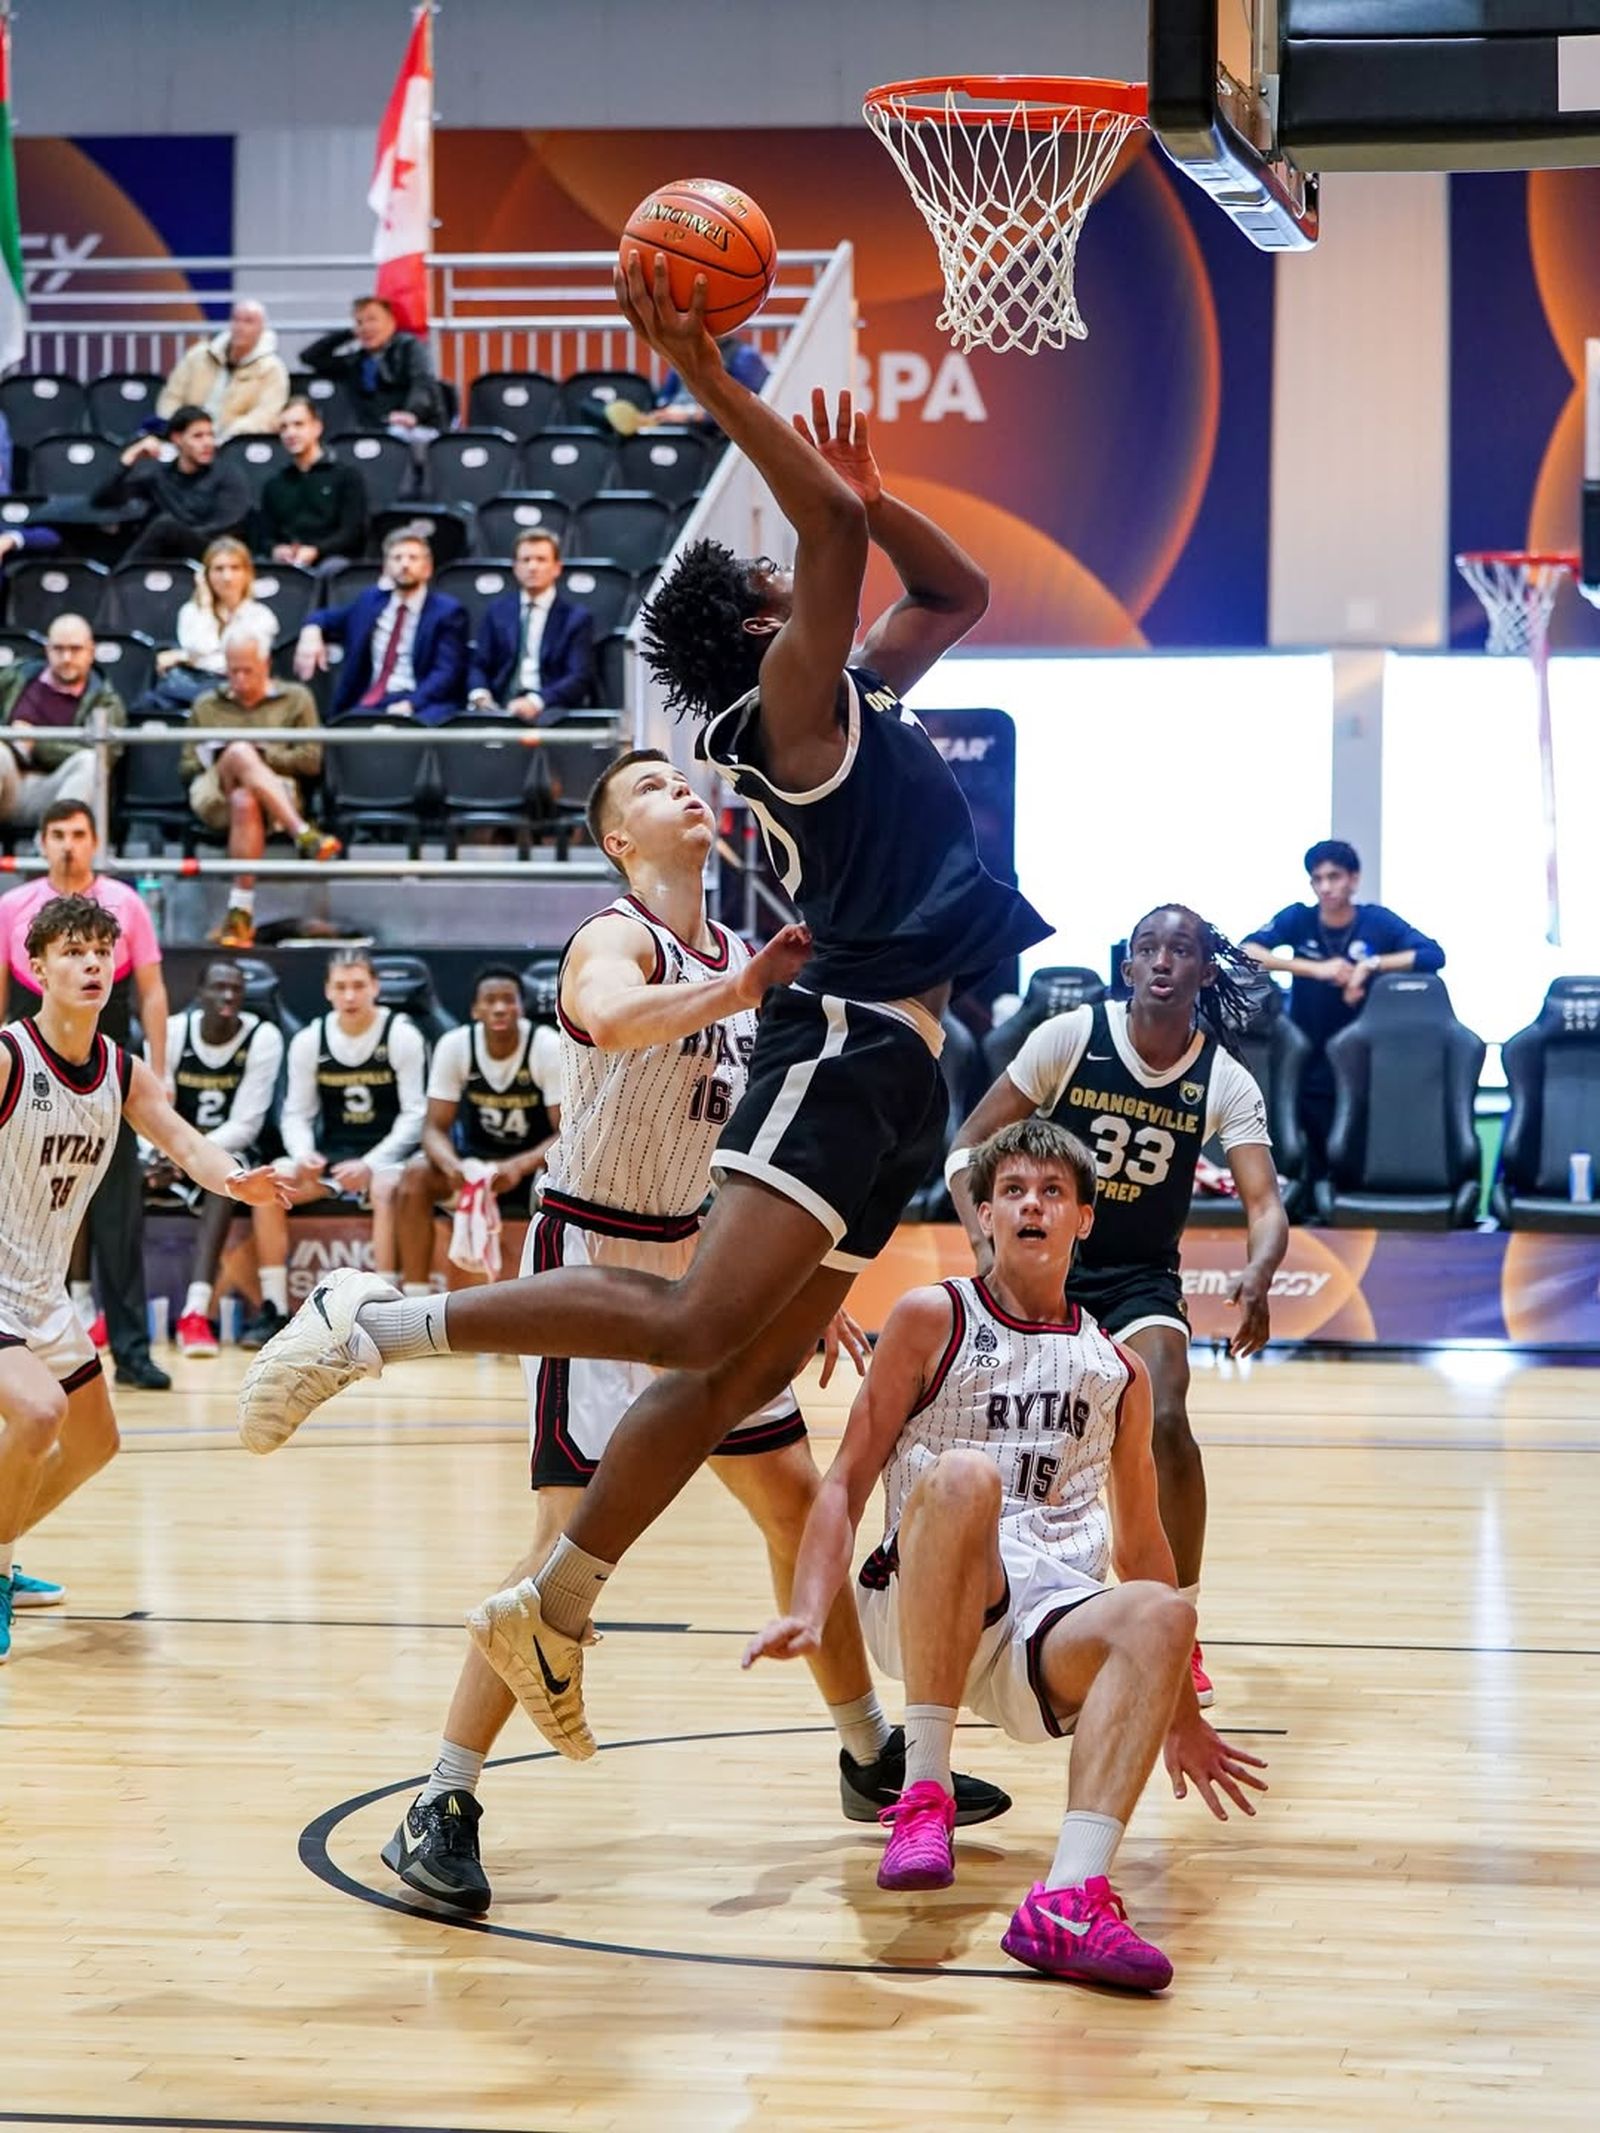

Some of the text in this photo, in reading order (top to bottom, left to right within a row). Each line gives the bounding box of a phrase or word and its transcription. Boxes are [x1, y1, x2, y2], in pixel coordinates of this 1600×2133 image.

[196, 1090, 226, 1126] 2
[343, 1086, 374, 1112] 3
[478, 1106, 530, 1138] 24
[689, 1074, 731, 1125] 16
[1069, 1087, 1199, 1134] ORANGEVILLE
[1090, 1114, 1176, 1186] 33
[1096, 1179, 1142, 1203] PREP
[987, 1391, 1091, 1441] RYTAS
[1014, 1449, 1061, 1502] 15
